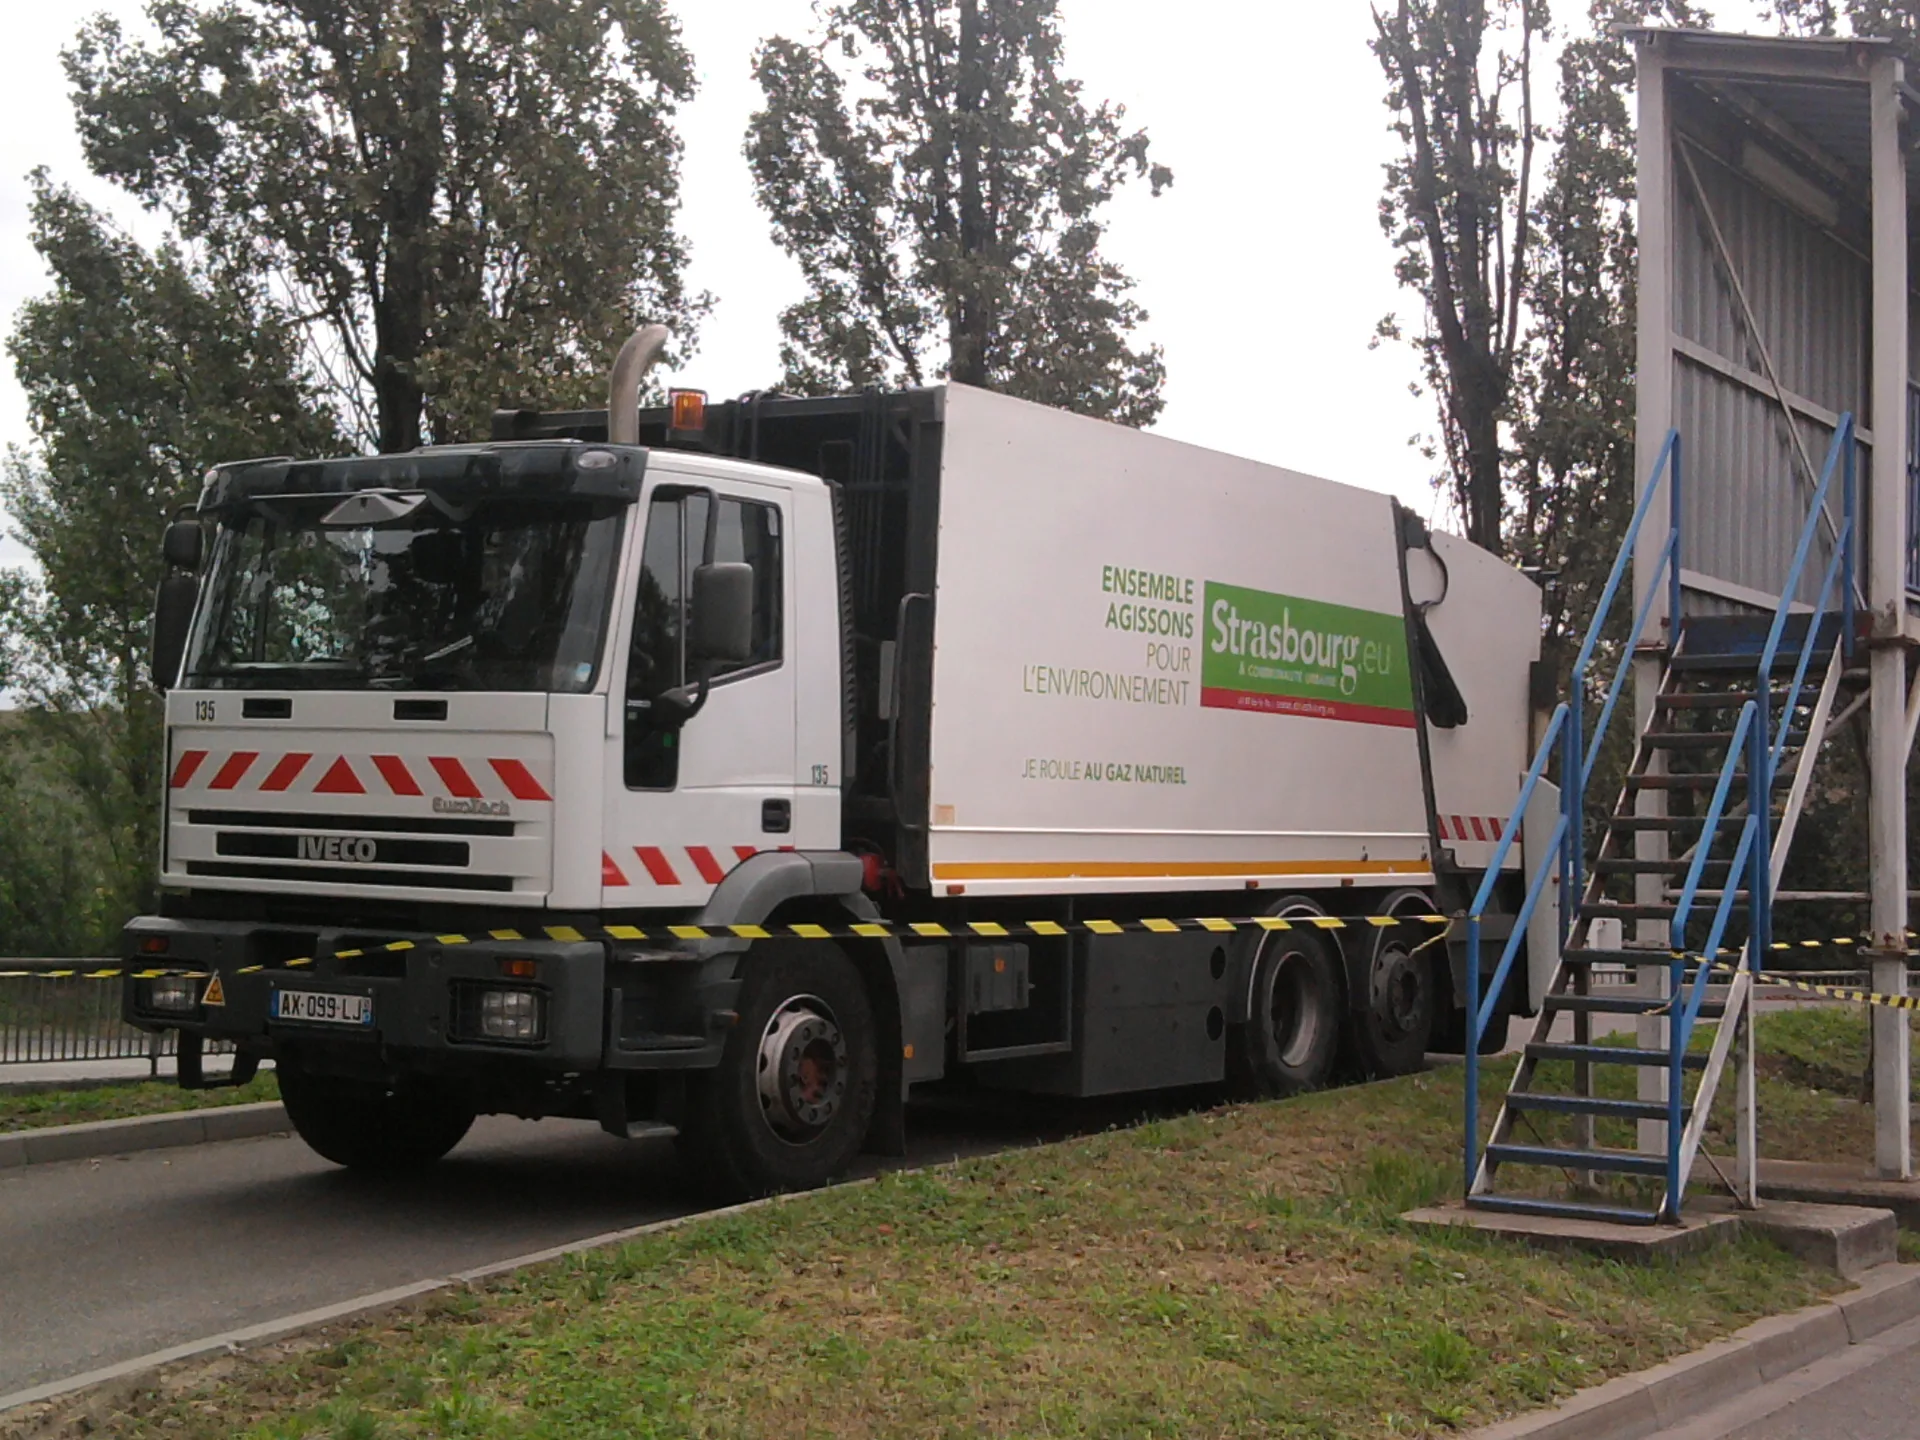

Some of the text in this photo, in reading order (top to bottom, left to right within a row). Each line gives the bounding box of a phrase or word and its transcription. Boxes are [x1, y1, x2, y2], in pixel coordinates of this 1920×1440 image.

[1102, 565, 1194, 604] ENSEMBLE
[1105, 601, 1194, 639] AGISSONS
[1146, 642, 1191, 673] POUR
[1023, 665, 1190, 706] L'ENVIRONNEMENT
[195, 700, 215, 721] 135
[811, 764, 828, 785] 135
[1022, 758, 1187, 785] JE ROULE AU GAZ NATUREL
[298, 836, 377, 861] IVECO
